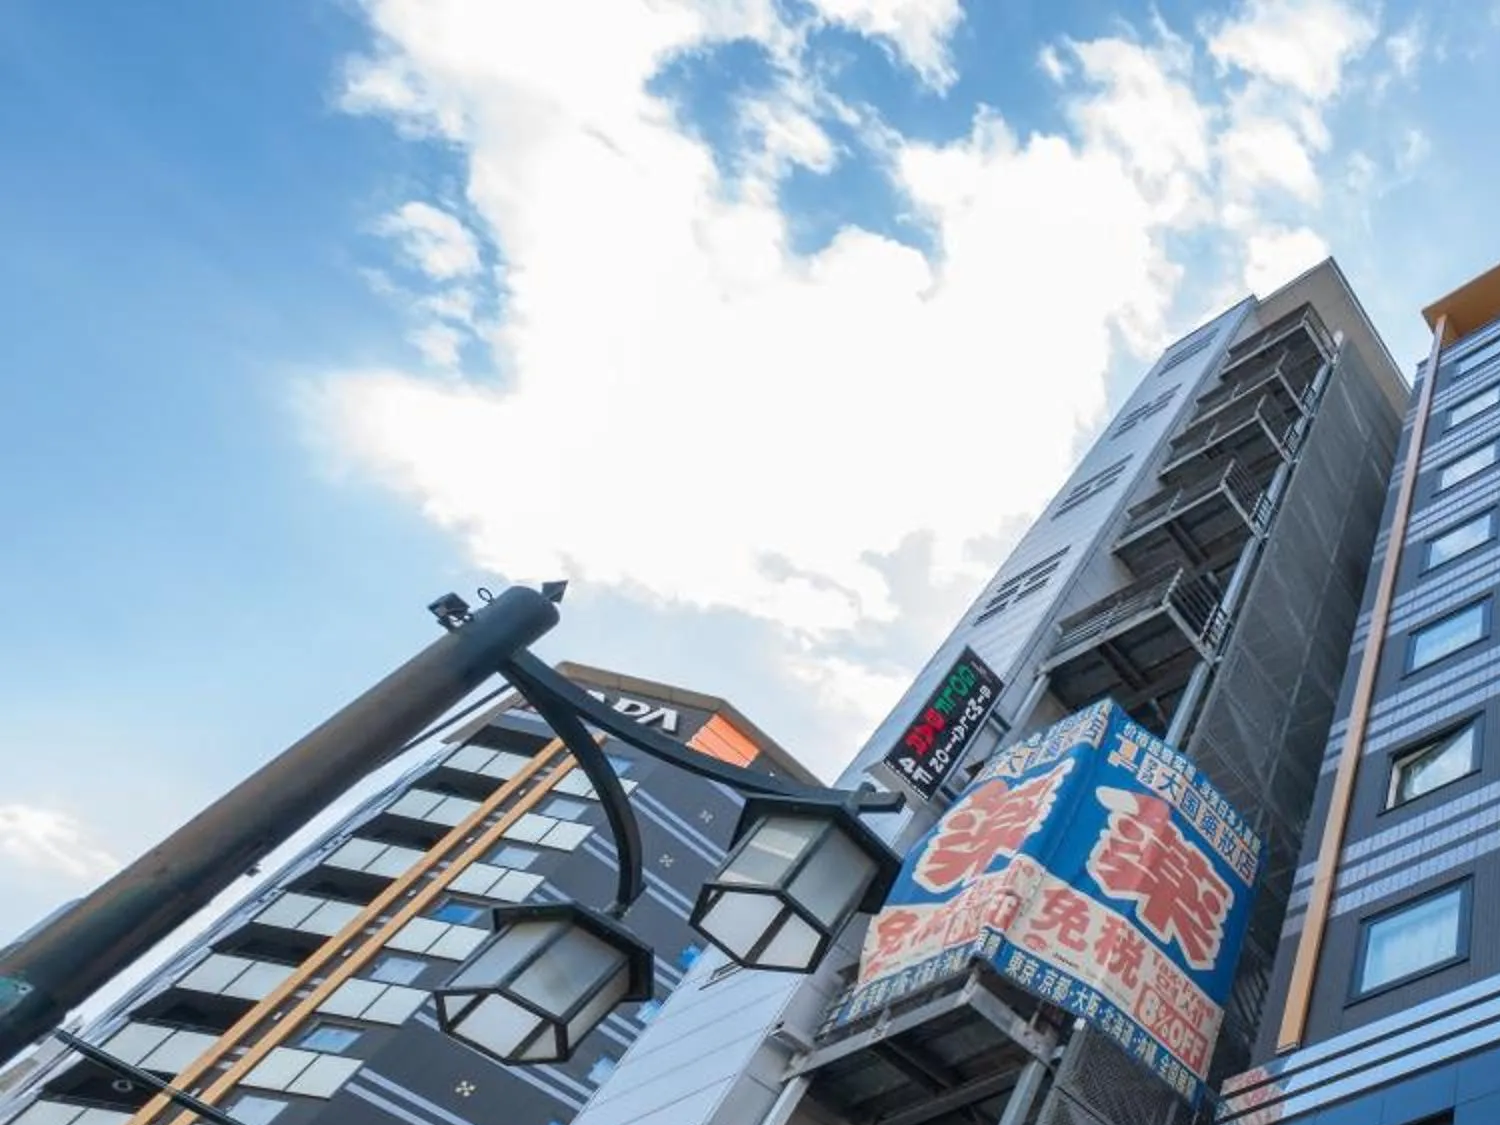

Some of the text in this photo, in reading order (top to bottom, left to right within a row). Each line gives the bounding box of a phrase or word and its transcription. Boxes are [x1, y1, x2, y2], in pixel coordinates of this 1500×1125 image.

[906, 708, 945, 755] BAR
[929, 685, 992, 773] SIMULATION
[898, 757, 933, 784] 4F
[1030, 886, 1148, 990] 免税
